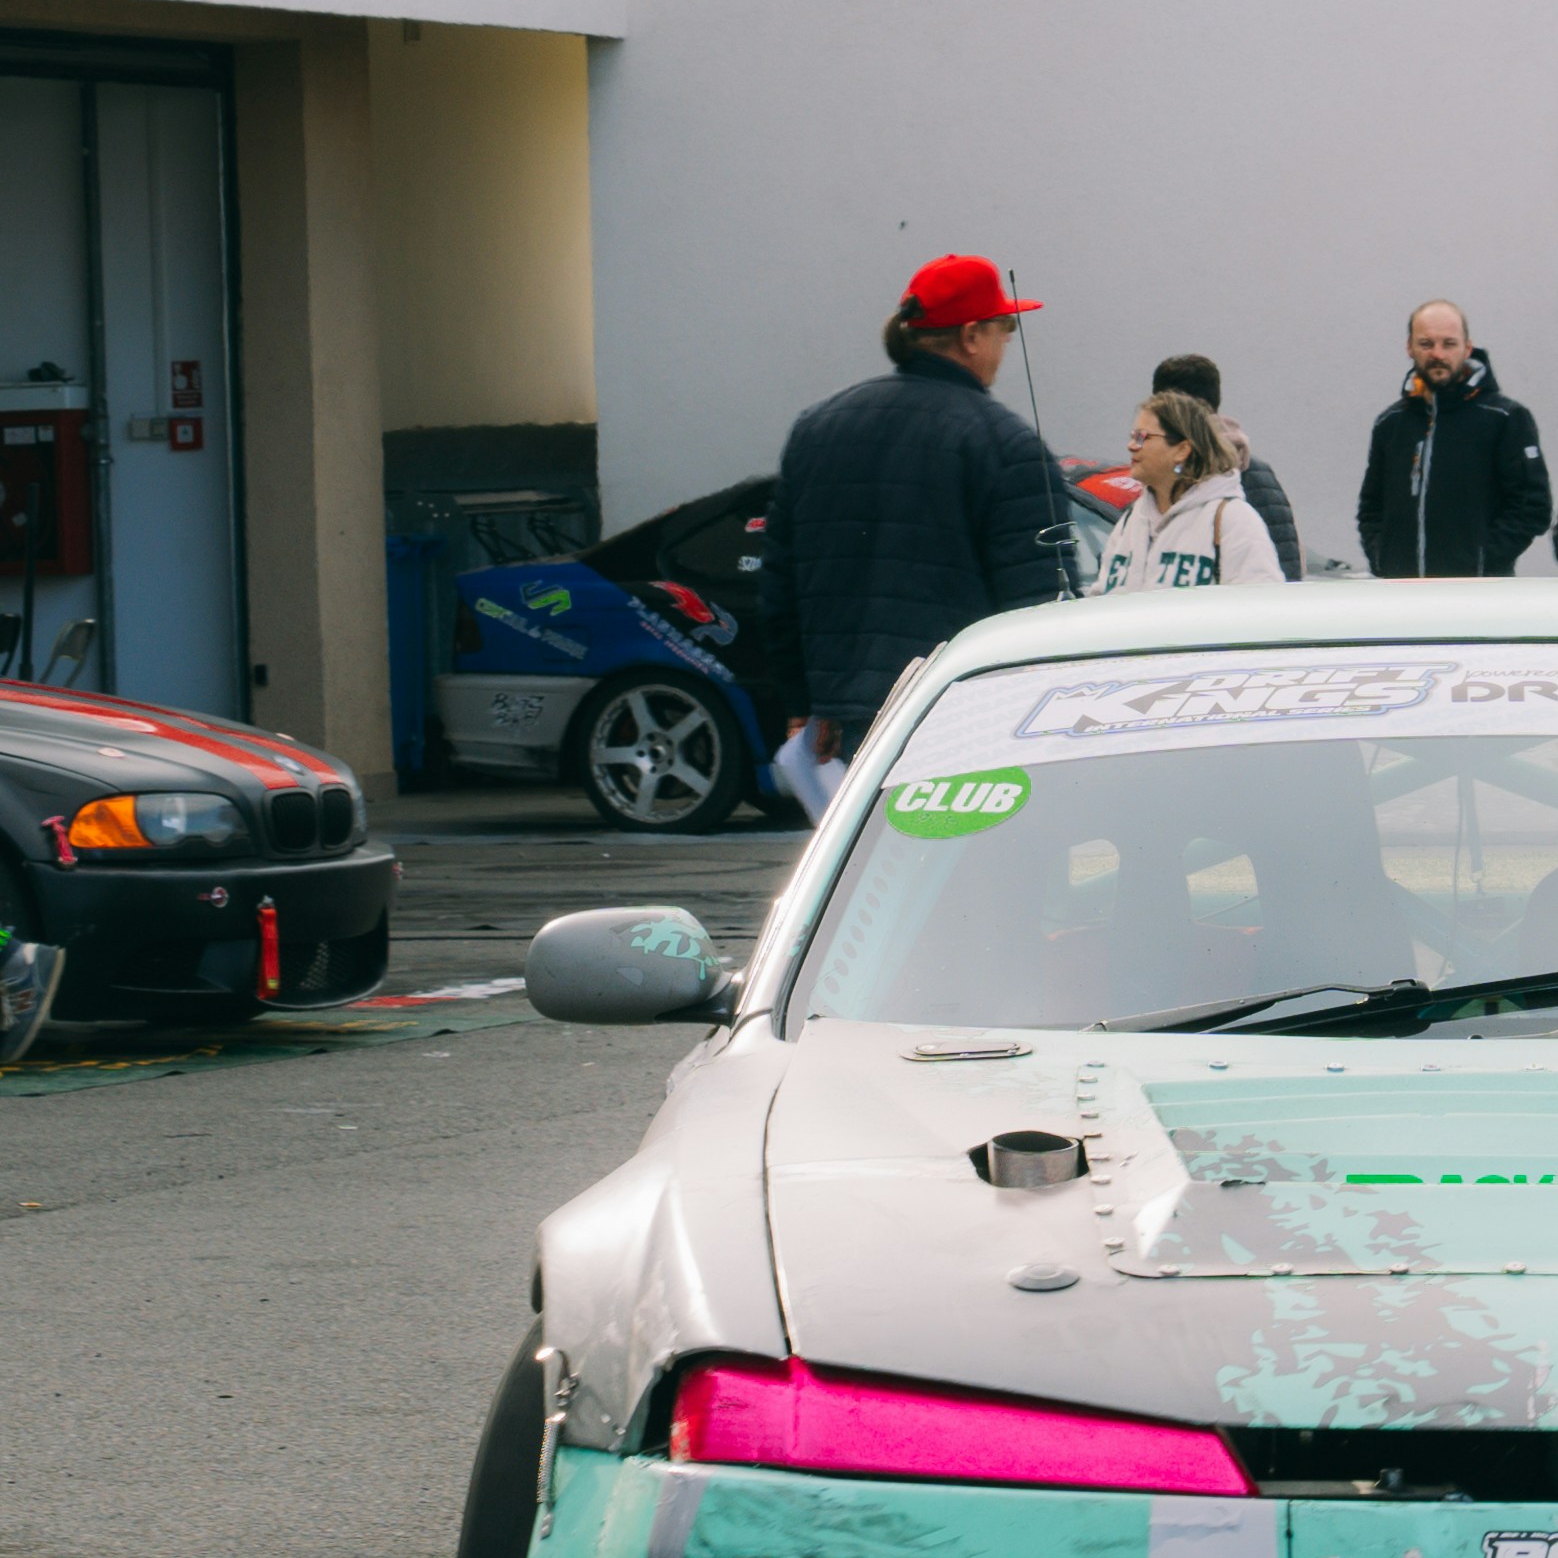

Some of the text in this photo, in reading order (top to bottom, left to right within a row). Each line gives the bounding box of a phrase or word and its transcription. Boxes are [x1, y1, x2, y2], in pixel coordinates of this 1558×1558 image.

[1186, 666, 1450, 691] DRIFT
[1085, 705, 1373, 732] INTERNATIONAL SERIES
[894, 781, 1023, 813] CLUB
